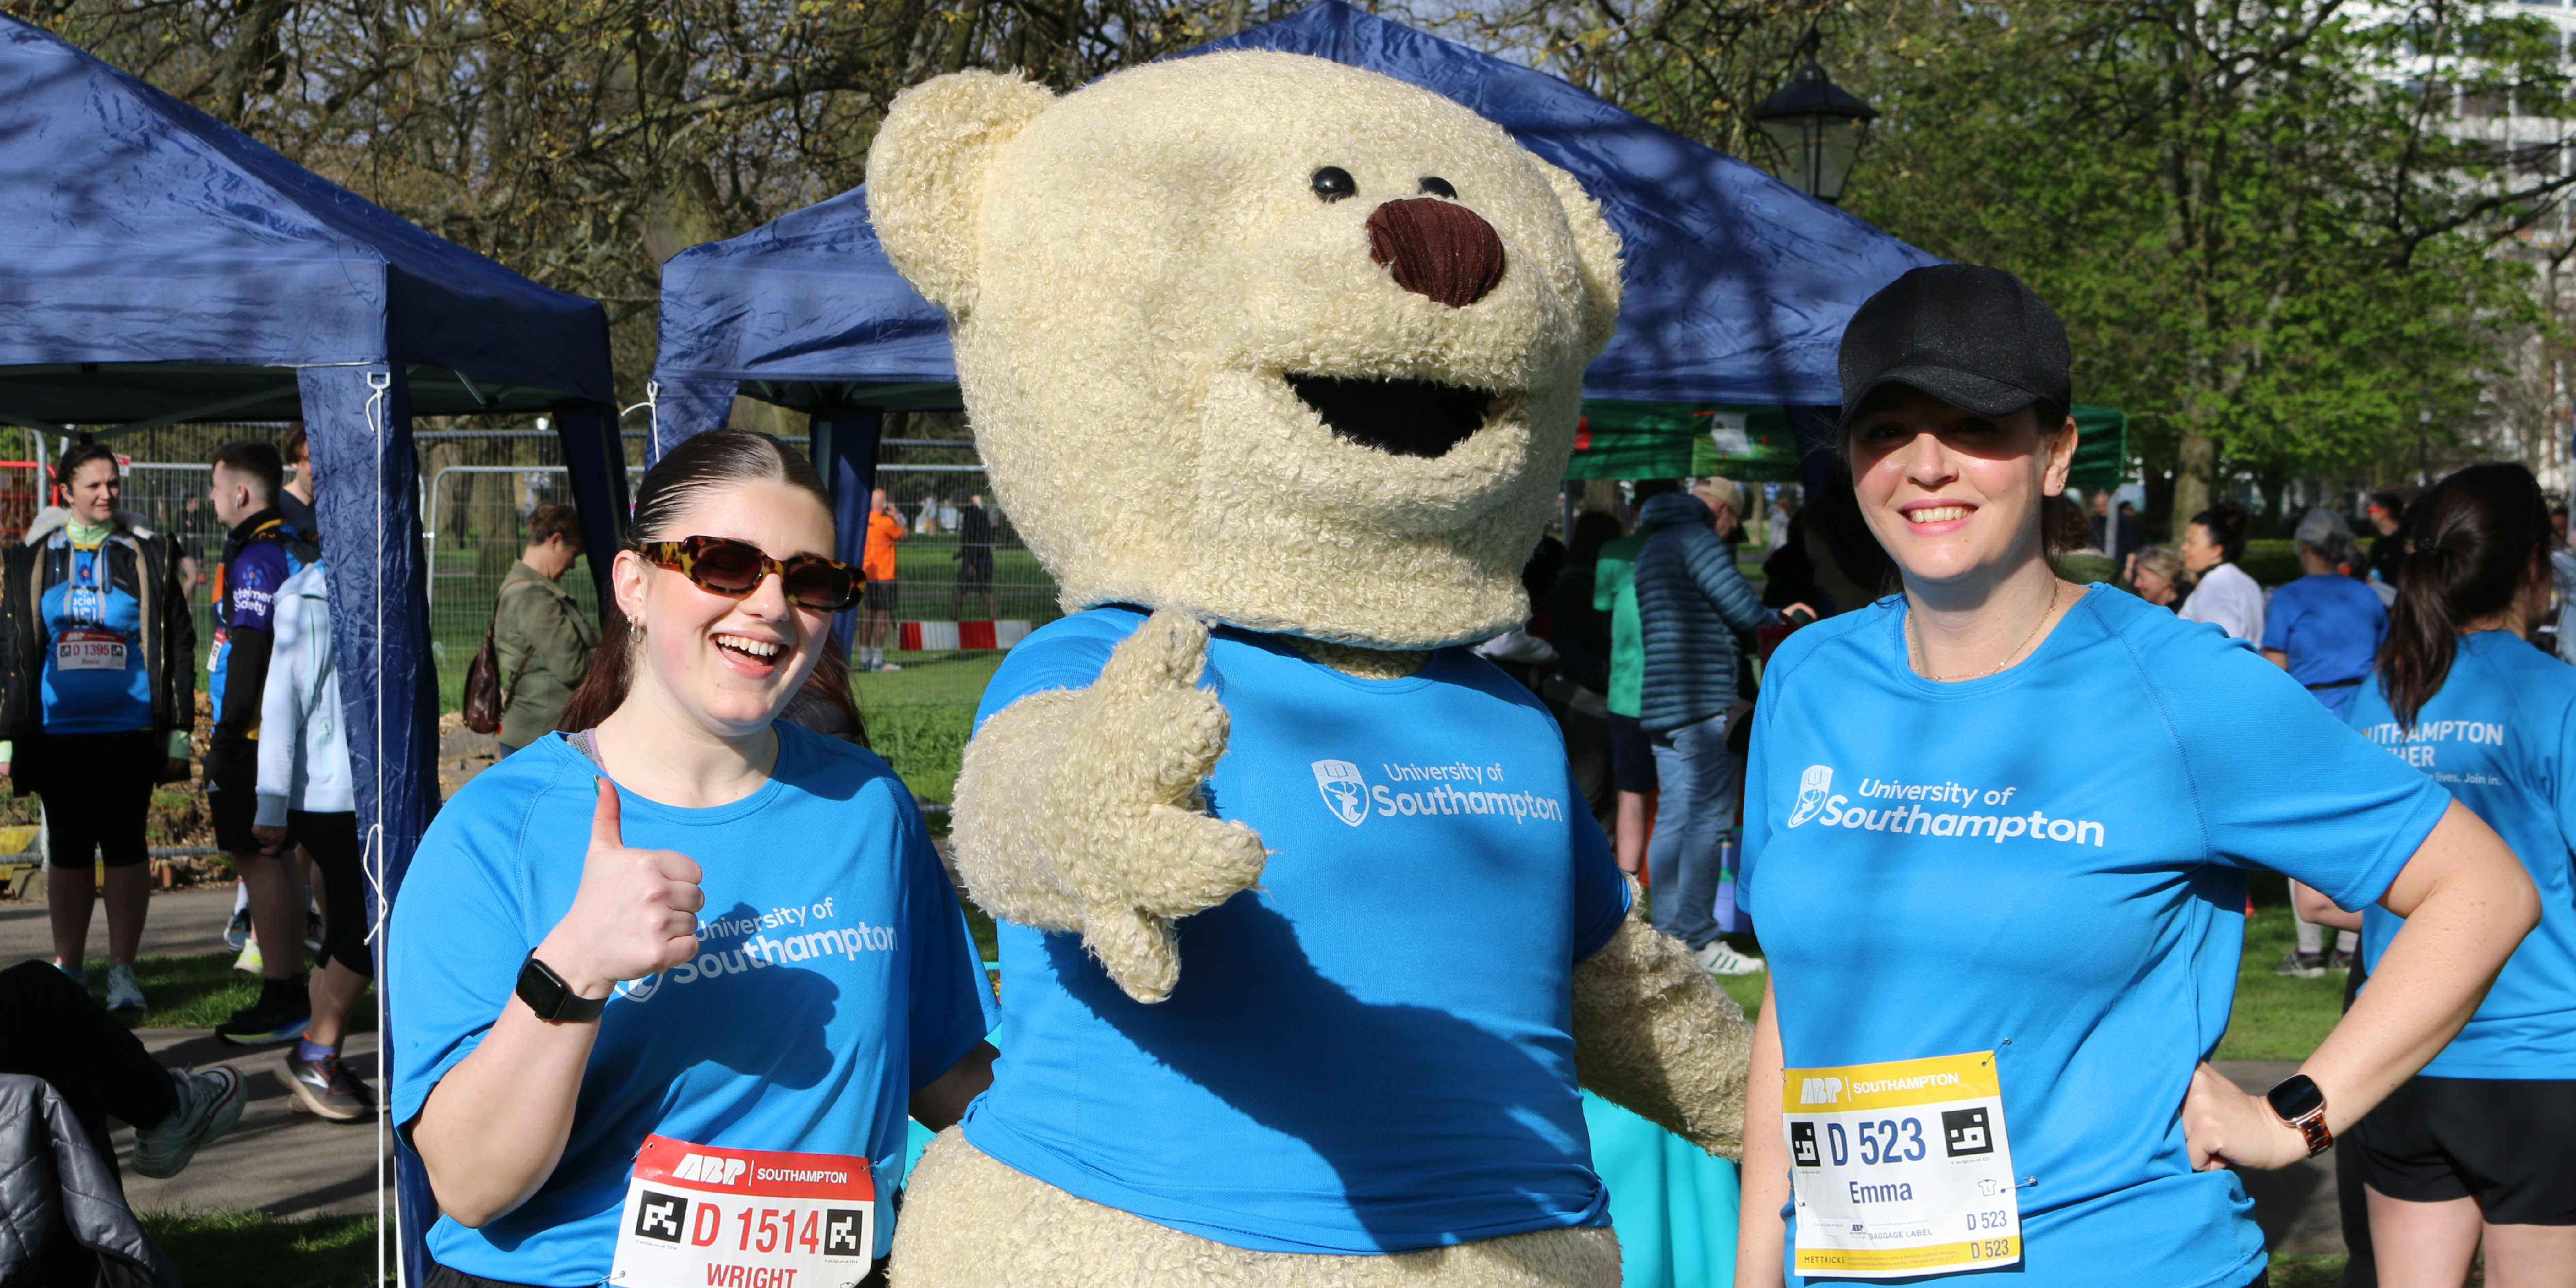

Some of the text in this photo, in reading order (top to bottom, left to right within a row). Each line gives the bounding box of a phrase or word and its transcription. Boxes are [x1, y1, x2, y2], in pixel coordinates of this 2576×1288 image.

[73, 645, 110, 656] D 1395
[2361, 721, 2503, 745] UTHAMPTON
[1383, 761, 1504, 785] University of
[2464, 773, 2486, 784] Join
[2488, 776, 2502, 786] in.
[1372, 784, 1563, 824] Southampton
[1858, 778, 2016, 808] University of
[1819, 794, 2105, 848] Southampton
[694, 897, 834, 942] University of
[673, 922, 899, 984] Southampton
[1800, 1072, 1960, 1104] ABP SOUTHAMPTON
[1827, 1117, 1926, 1166] D 523
[672, 1153, 848, 1185] ABP SOUTHAMPTON
[1849, 1181, 1913, 1204] Emma
[691, 1202, 819, 1255] D 1514
[1967, 1210, 2007, 1230] D 523
[1869, 1231, 1904, 1240] BAGGAGE
[1906, 1228, 1933, 1238] LABEL
[1971, 1239, 2009, 1259] D 523
[707, 1263, 798, 1288] WRIGHT
